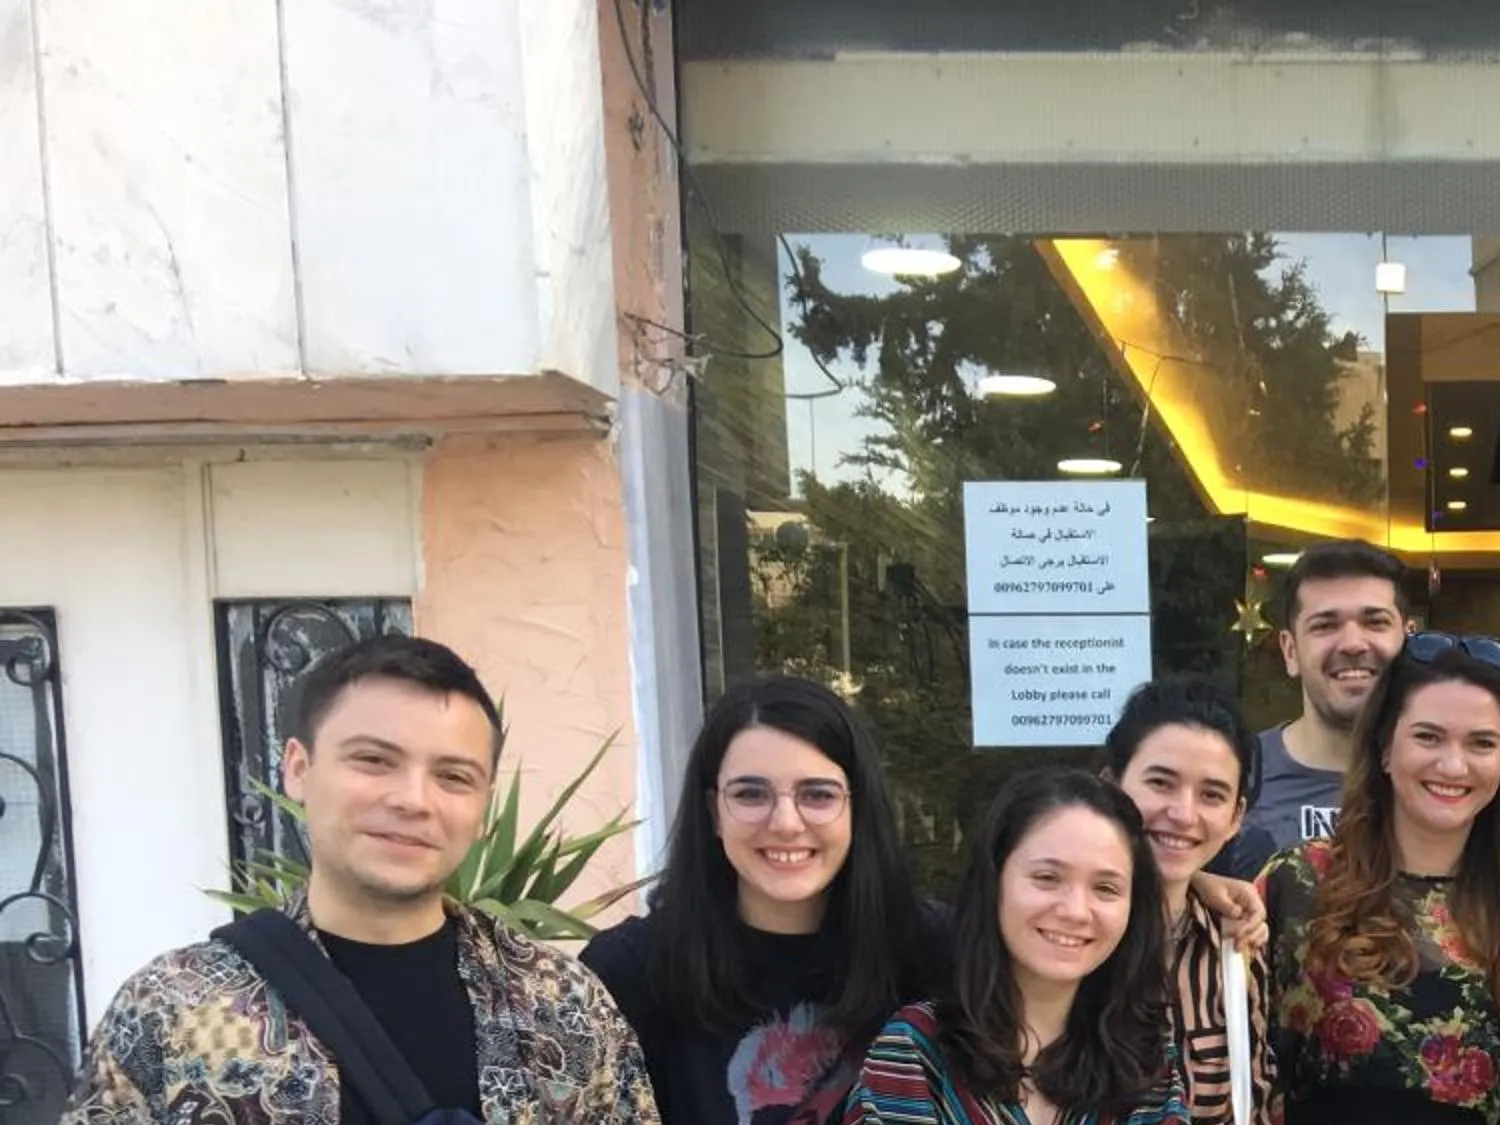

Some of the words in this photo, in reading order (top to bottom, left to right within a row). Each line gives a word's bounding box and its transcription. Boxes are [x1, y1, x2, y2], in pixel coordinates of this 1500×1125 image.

[1096, 501, 1111, 517] في
[988, 638, 1000, 649] In
[1002, 639, 1029, 649] case
[1031, 637, 1052, 649] the
[1004, 664, 1049, 675] doesn't
[1051, 662, 1079, 675] exist
[1082, 663, 1094, 673] in
[1096, 663, 1117, 673] the
[1011, 689, 1047, 702] Lobby
[1050, 688, 1088, 701] please
[1091, 688, 1111, 699] call
